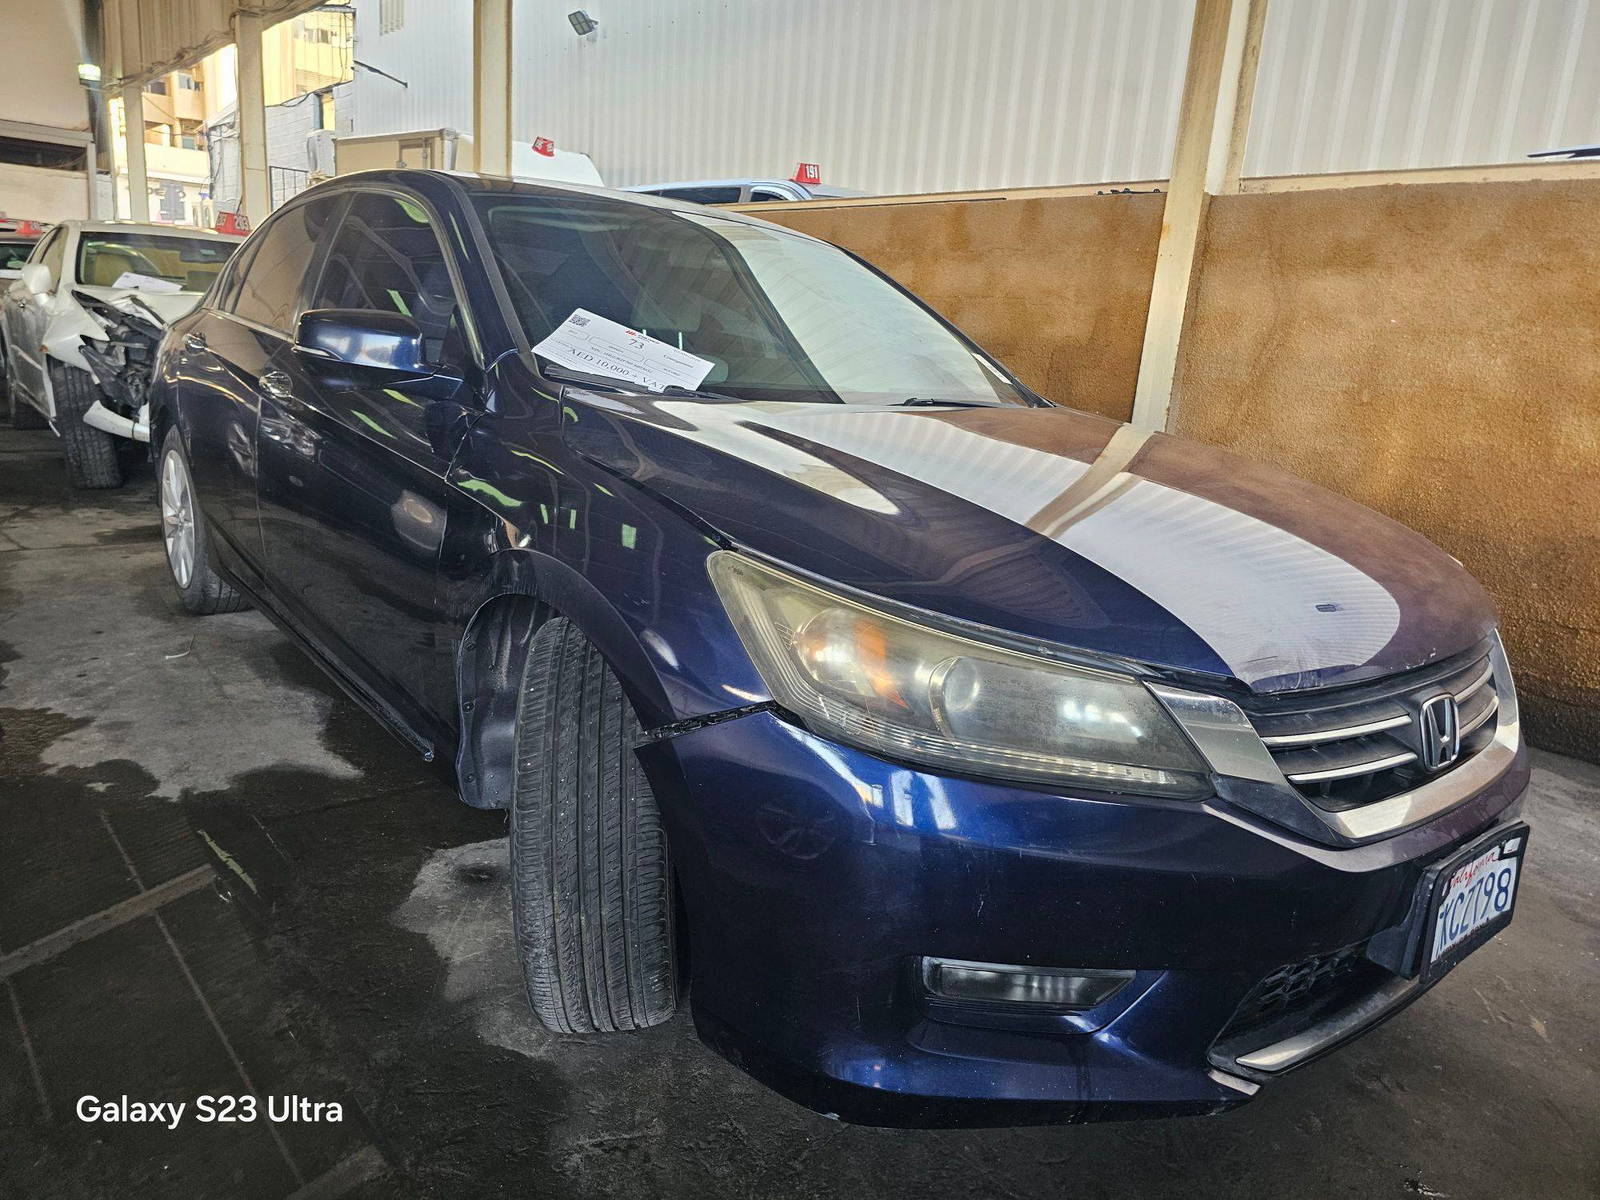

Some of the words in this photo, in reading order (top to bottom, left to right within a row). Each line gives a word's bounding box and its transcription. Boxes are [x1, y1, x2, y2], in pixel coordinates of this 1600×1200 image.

[805, 165, 818, 179] 191
[628, 338, 645, 349] 73
[567, 349, 593, 361] AED
[1450, 851, 1498, 888] alifornia
